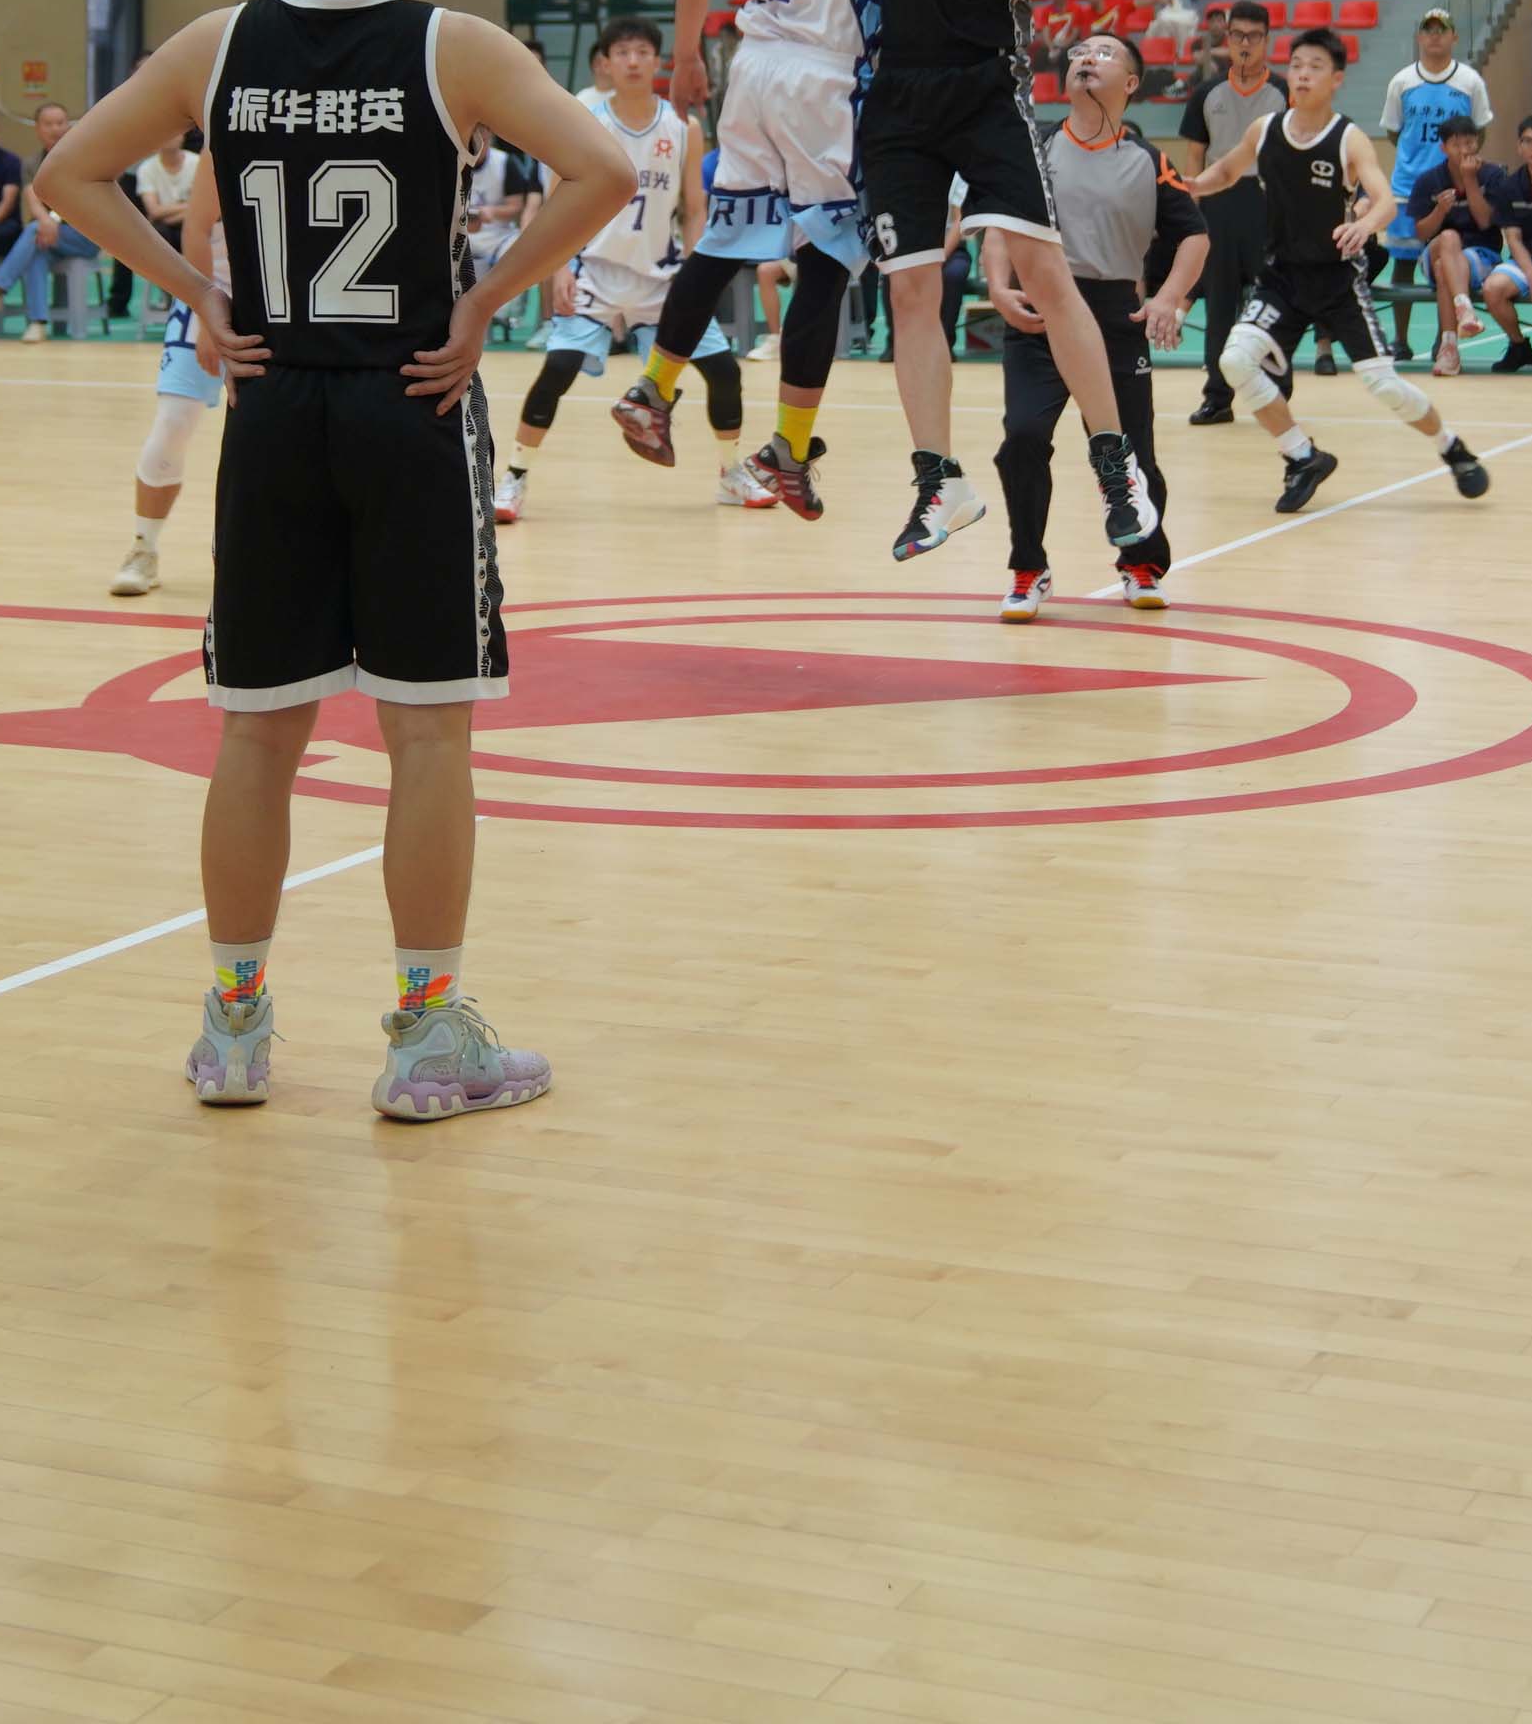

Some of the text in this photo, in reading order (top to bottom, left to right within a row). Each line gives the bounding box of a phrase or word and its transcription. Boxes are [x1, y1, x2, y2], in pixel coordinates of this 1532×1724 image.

[227, 85, 405, 134] 振华群英
[239, 159, 399, 325] 12
[875, 212, 898, 256] 6
